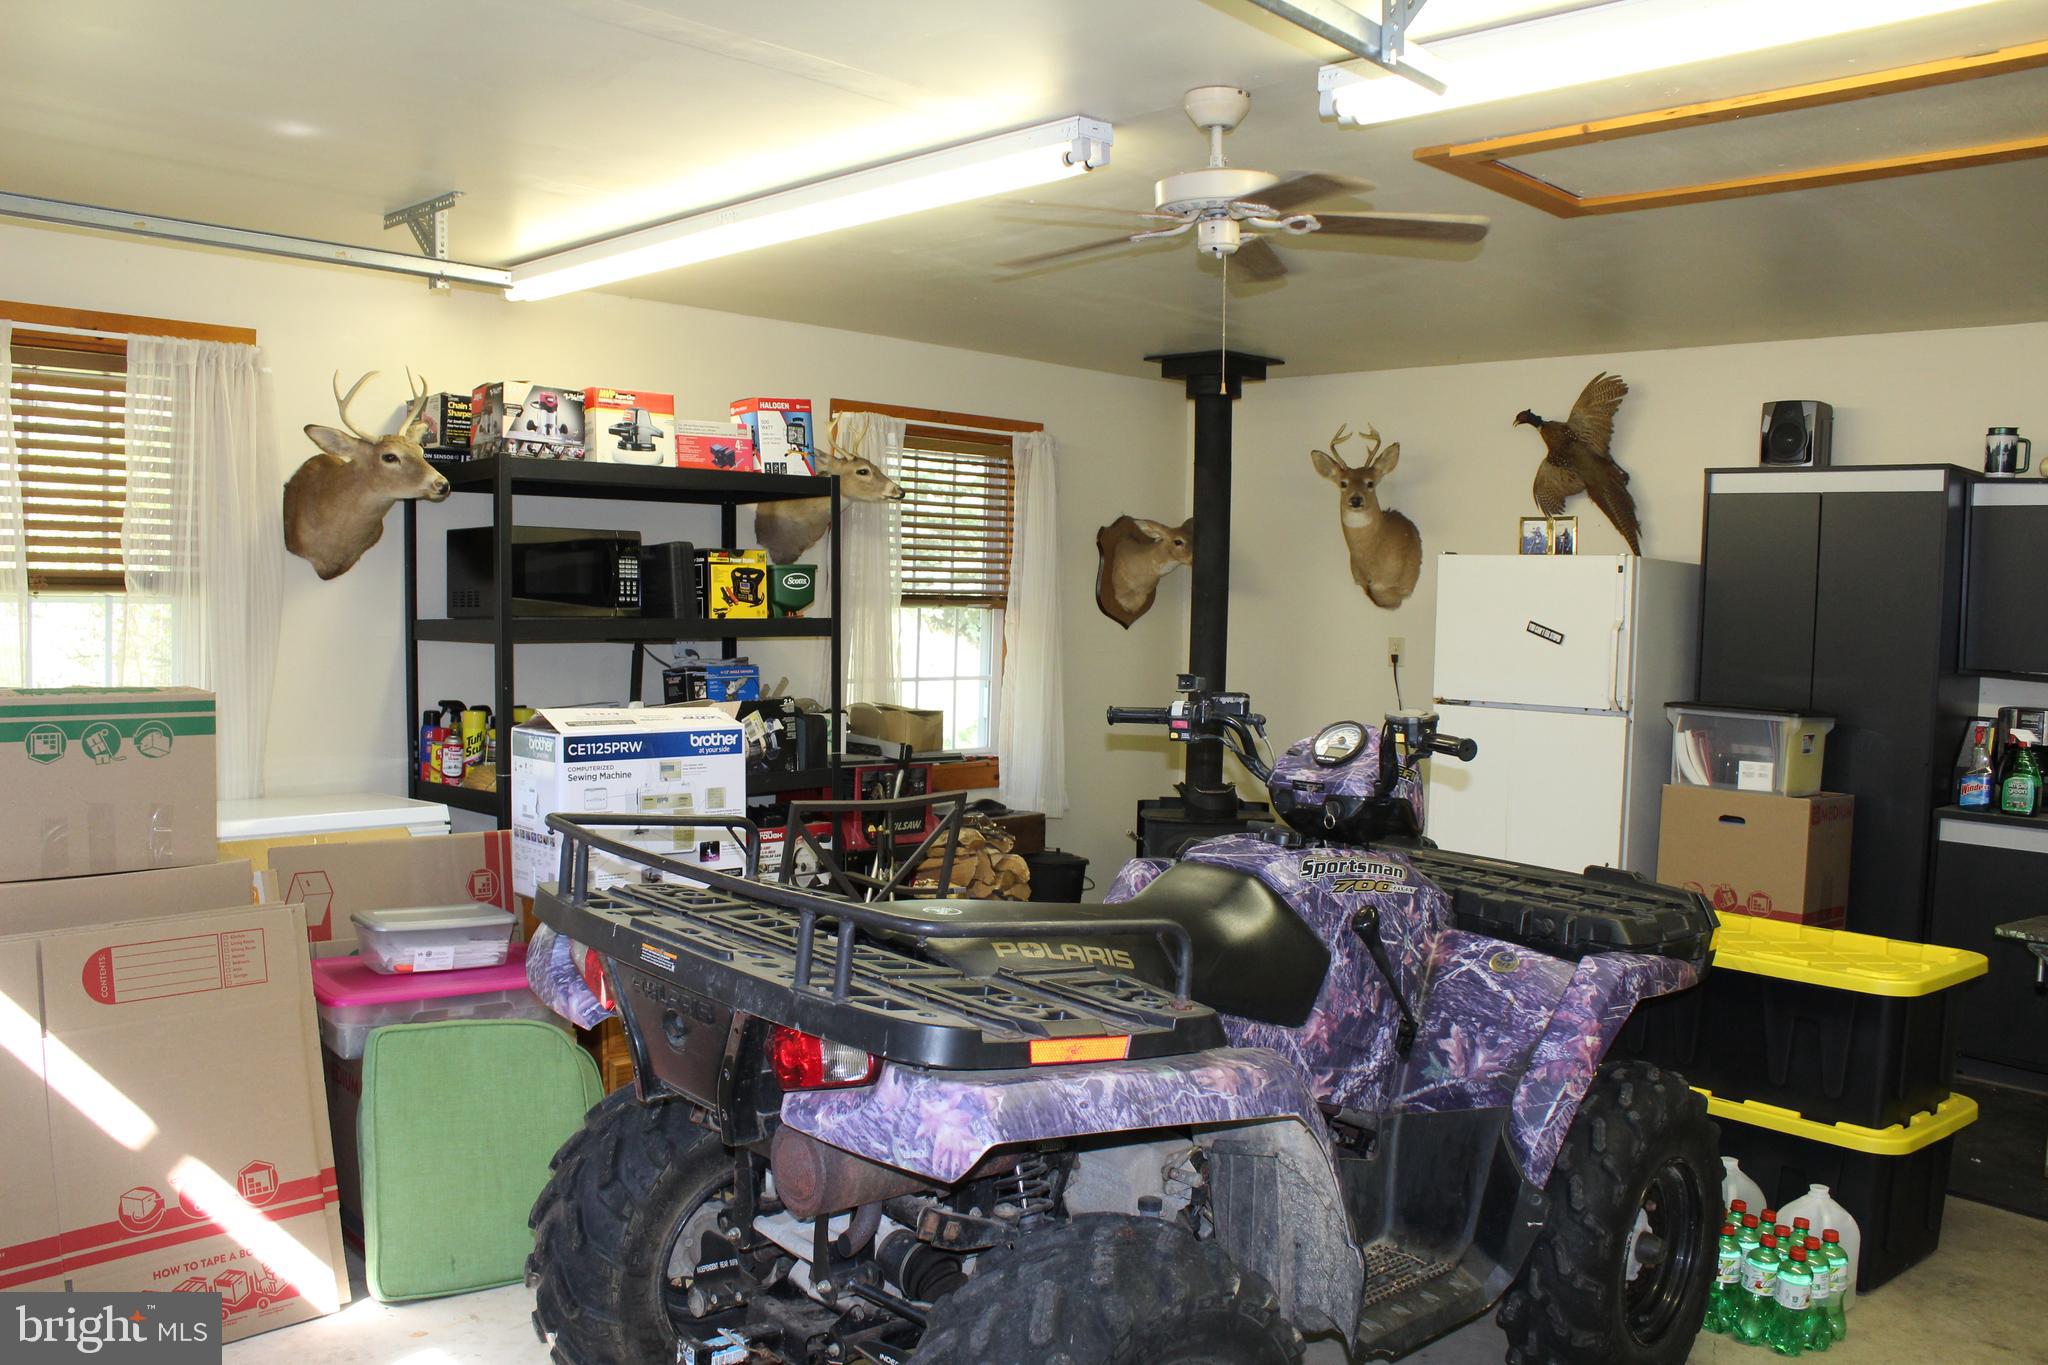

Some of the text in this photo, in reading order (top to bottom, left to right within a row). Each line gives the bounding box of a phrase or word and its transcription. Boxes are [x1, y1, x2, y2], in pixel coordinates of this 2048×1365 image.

[448, 401, 467, 410] Chain
[759, 401, 790, 410] HALOGEN
[447, 409, 472, 419] Sharpe
[787, 576, 808, 585] Scotts
[467, 731, 483, 745] Tuff
[528, 736, 553, 752] brother
[690, 732, 739, 747] brother
[568, 741, 643, 756] CE1125PRW
[568, 764, 614, 772] COMPUTERIZED
[1398, 768, 1415, 781] EFI
[567, 771, 632, 782] Sewing Machine
[1300, 857, 1405, 880] Sportsman
[1330, 878, 1391, 895] 700
[992, 941, 1135, 969] POLARIS
[153, 1262, 181, 1280] HOW
[184, 1259, 199, 1272] TO
[200, 1254, 227, 1270] TAPE
[229, 1251, 239, 1262] A
